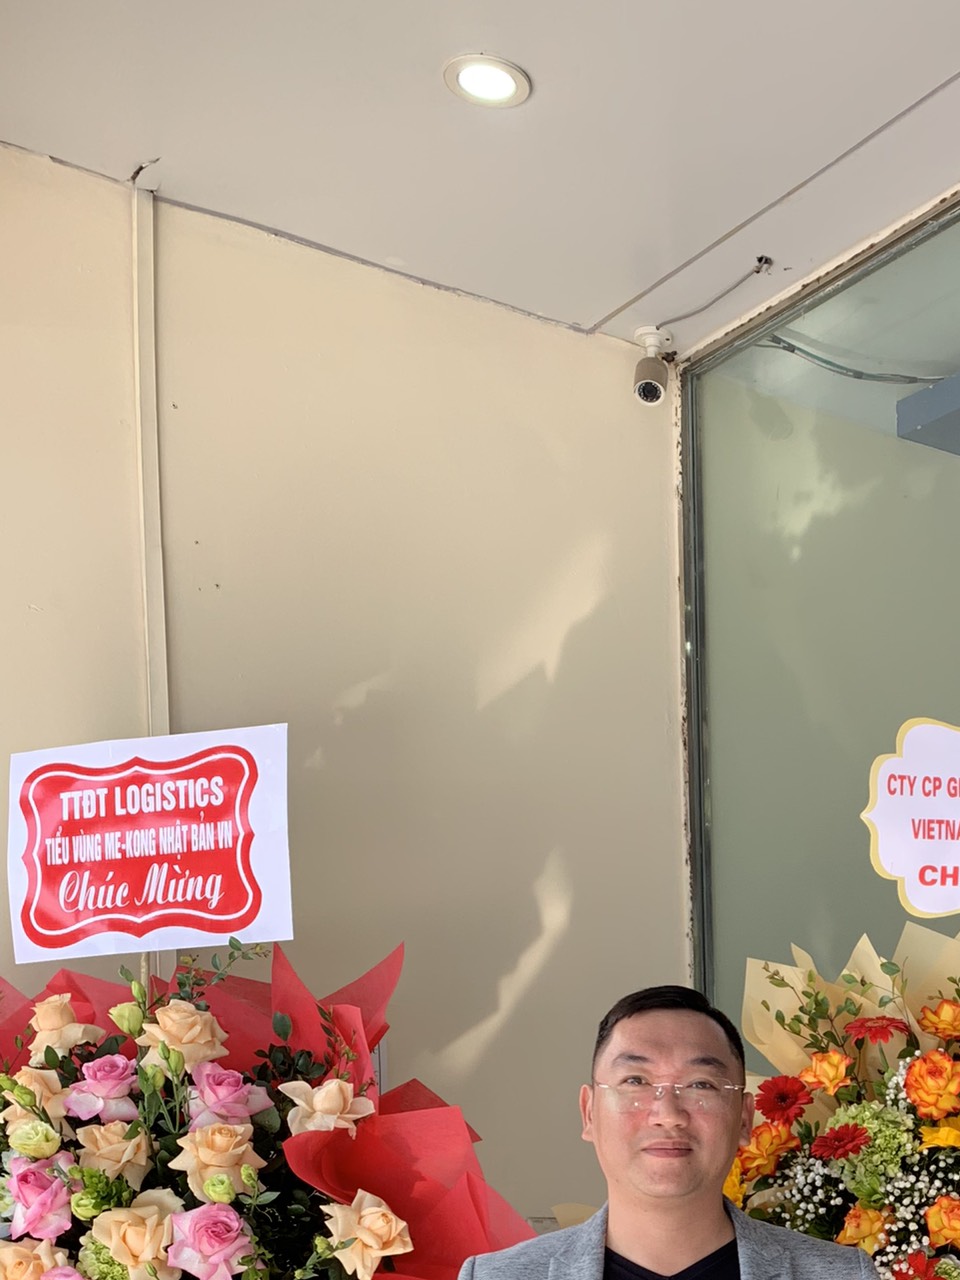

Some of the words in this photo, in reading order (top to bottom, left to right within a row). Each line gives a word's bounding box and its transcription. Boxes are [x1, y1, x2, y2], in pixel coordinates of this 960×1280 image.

[60, 787, 108, 821] TTĐT
[114, 776, 224, 816] LOGISTICS
[887, 774, 917, 797] CTY
[922, 775, 942, 797] CP
[45, 826, 70, 866] TIỂU
[72, 827, 101, 863] VÙNG
[104, 828, 156, 861] ME-KONG
[159, 820, 189, 860] NHẬT
[191, 811, 216, 852] BẢN
[217, 820, 233, 850] VN
[59, 869, 131, 913] Chúc
[134, 862, 225, 910] Mừng
